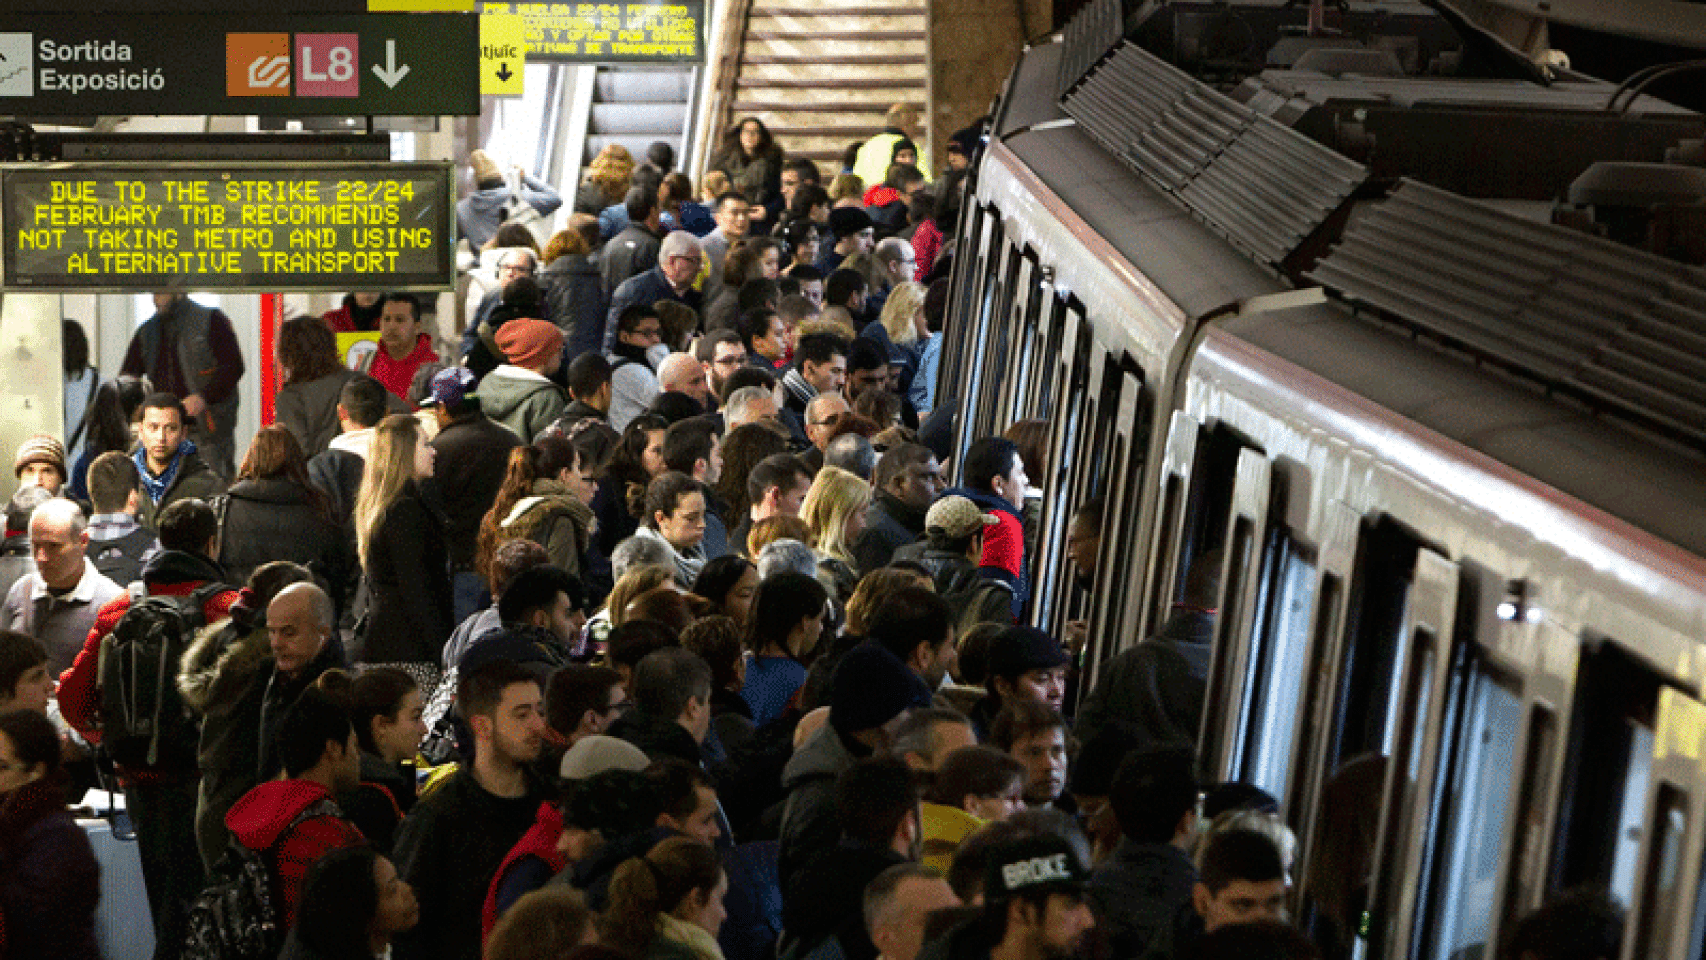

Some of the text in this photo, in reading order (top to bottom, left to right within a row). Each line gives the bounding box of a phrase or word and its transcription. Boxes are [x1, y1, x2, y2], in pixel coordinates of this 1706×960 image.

[40, 40, 131, 61] Sortida
[480, 43, 517, 60] tjuïc
[302, 46, 355, 82] L8
[40, 68, 165, 93] Exposició
[50, 181, 415, 203] DUE TO THE STRIKE 22/24
[35, 204, 399, 225] FEBRUARY TMB RECOMMENDS
[18, 228, 431, 249] NOT TAKING METRO AND USING
[67, 252, 399, 273] ALTERNATIVE TRANSPORT
[1002, 853, 1072, 890] BROKE
